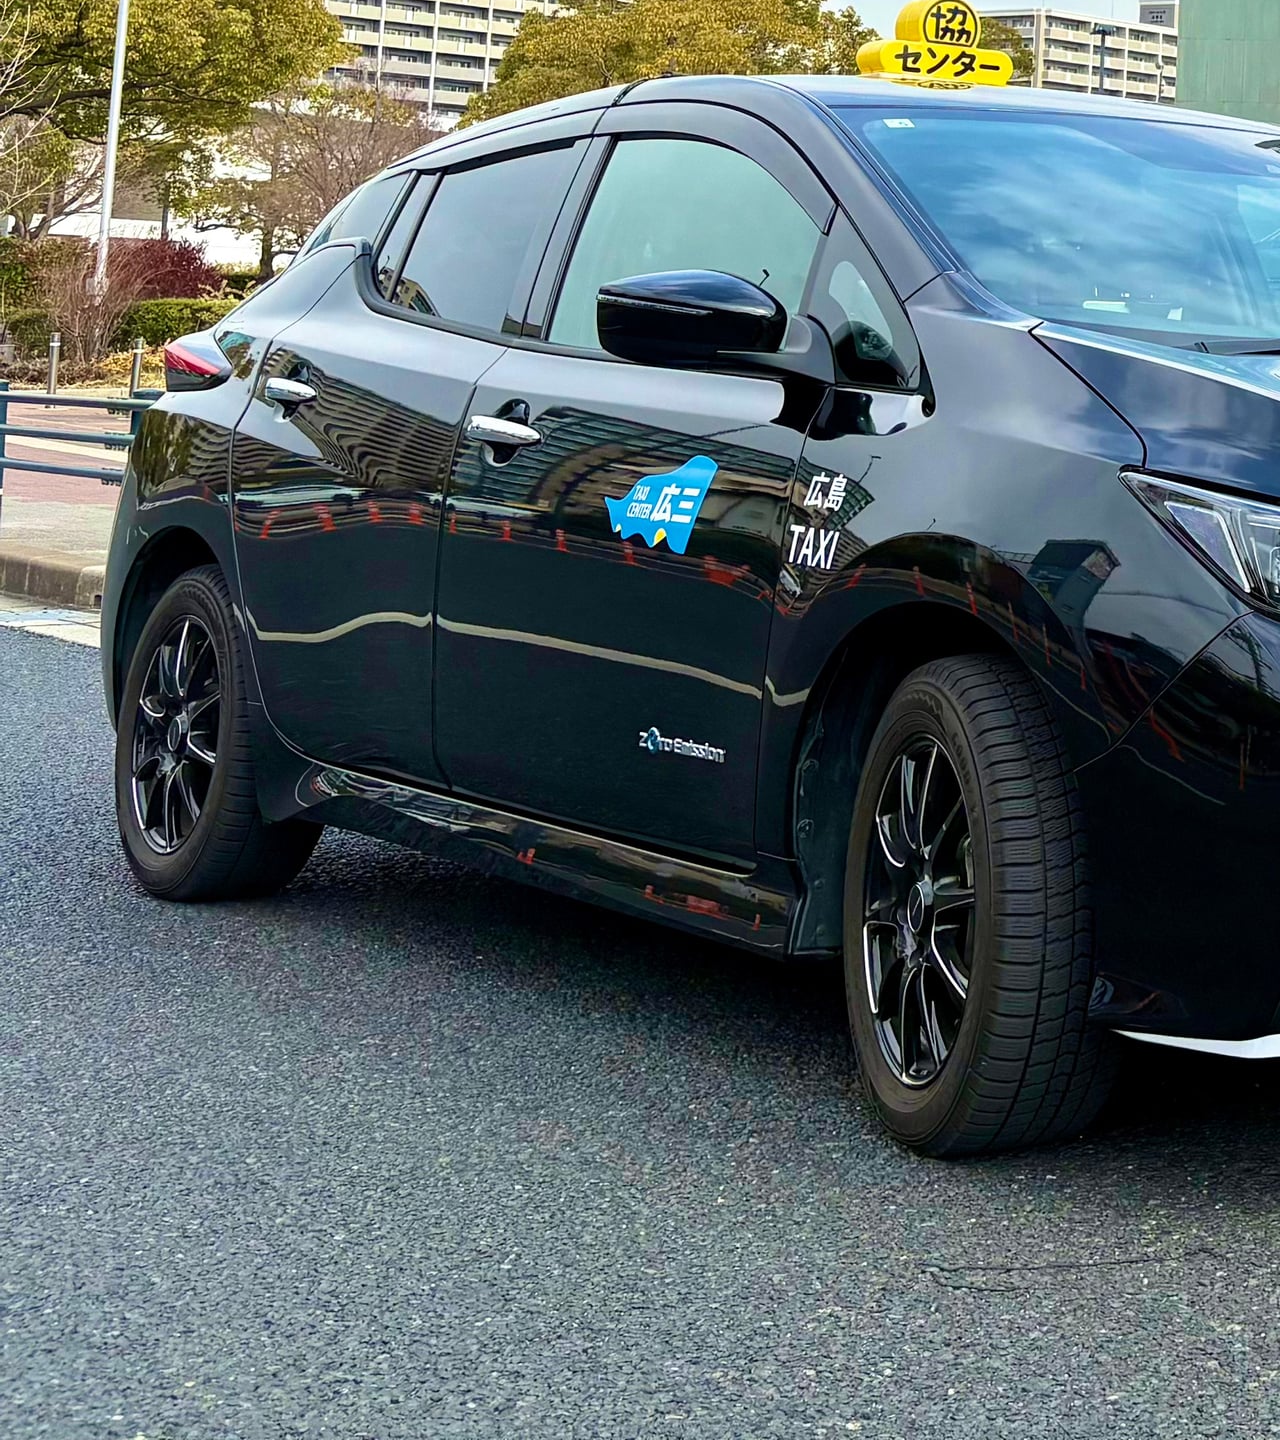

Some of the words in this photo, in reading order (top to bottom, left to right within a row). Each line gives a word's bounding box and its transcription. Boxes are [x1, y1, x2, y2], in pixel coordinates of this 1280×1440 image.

[930, 5, 972, 43] 協
[895, 44, 1000, 77] センター
[633, 485, 649, 501] TAXI
[803, 472, 847, 511] 広島
[626, 502, 652, 519] CENTER
[788, 524, 840, 570] TAXI
